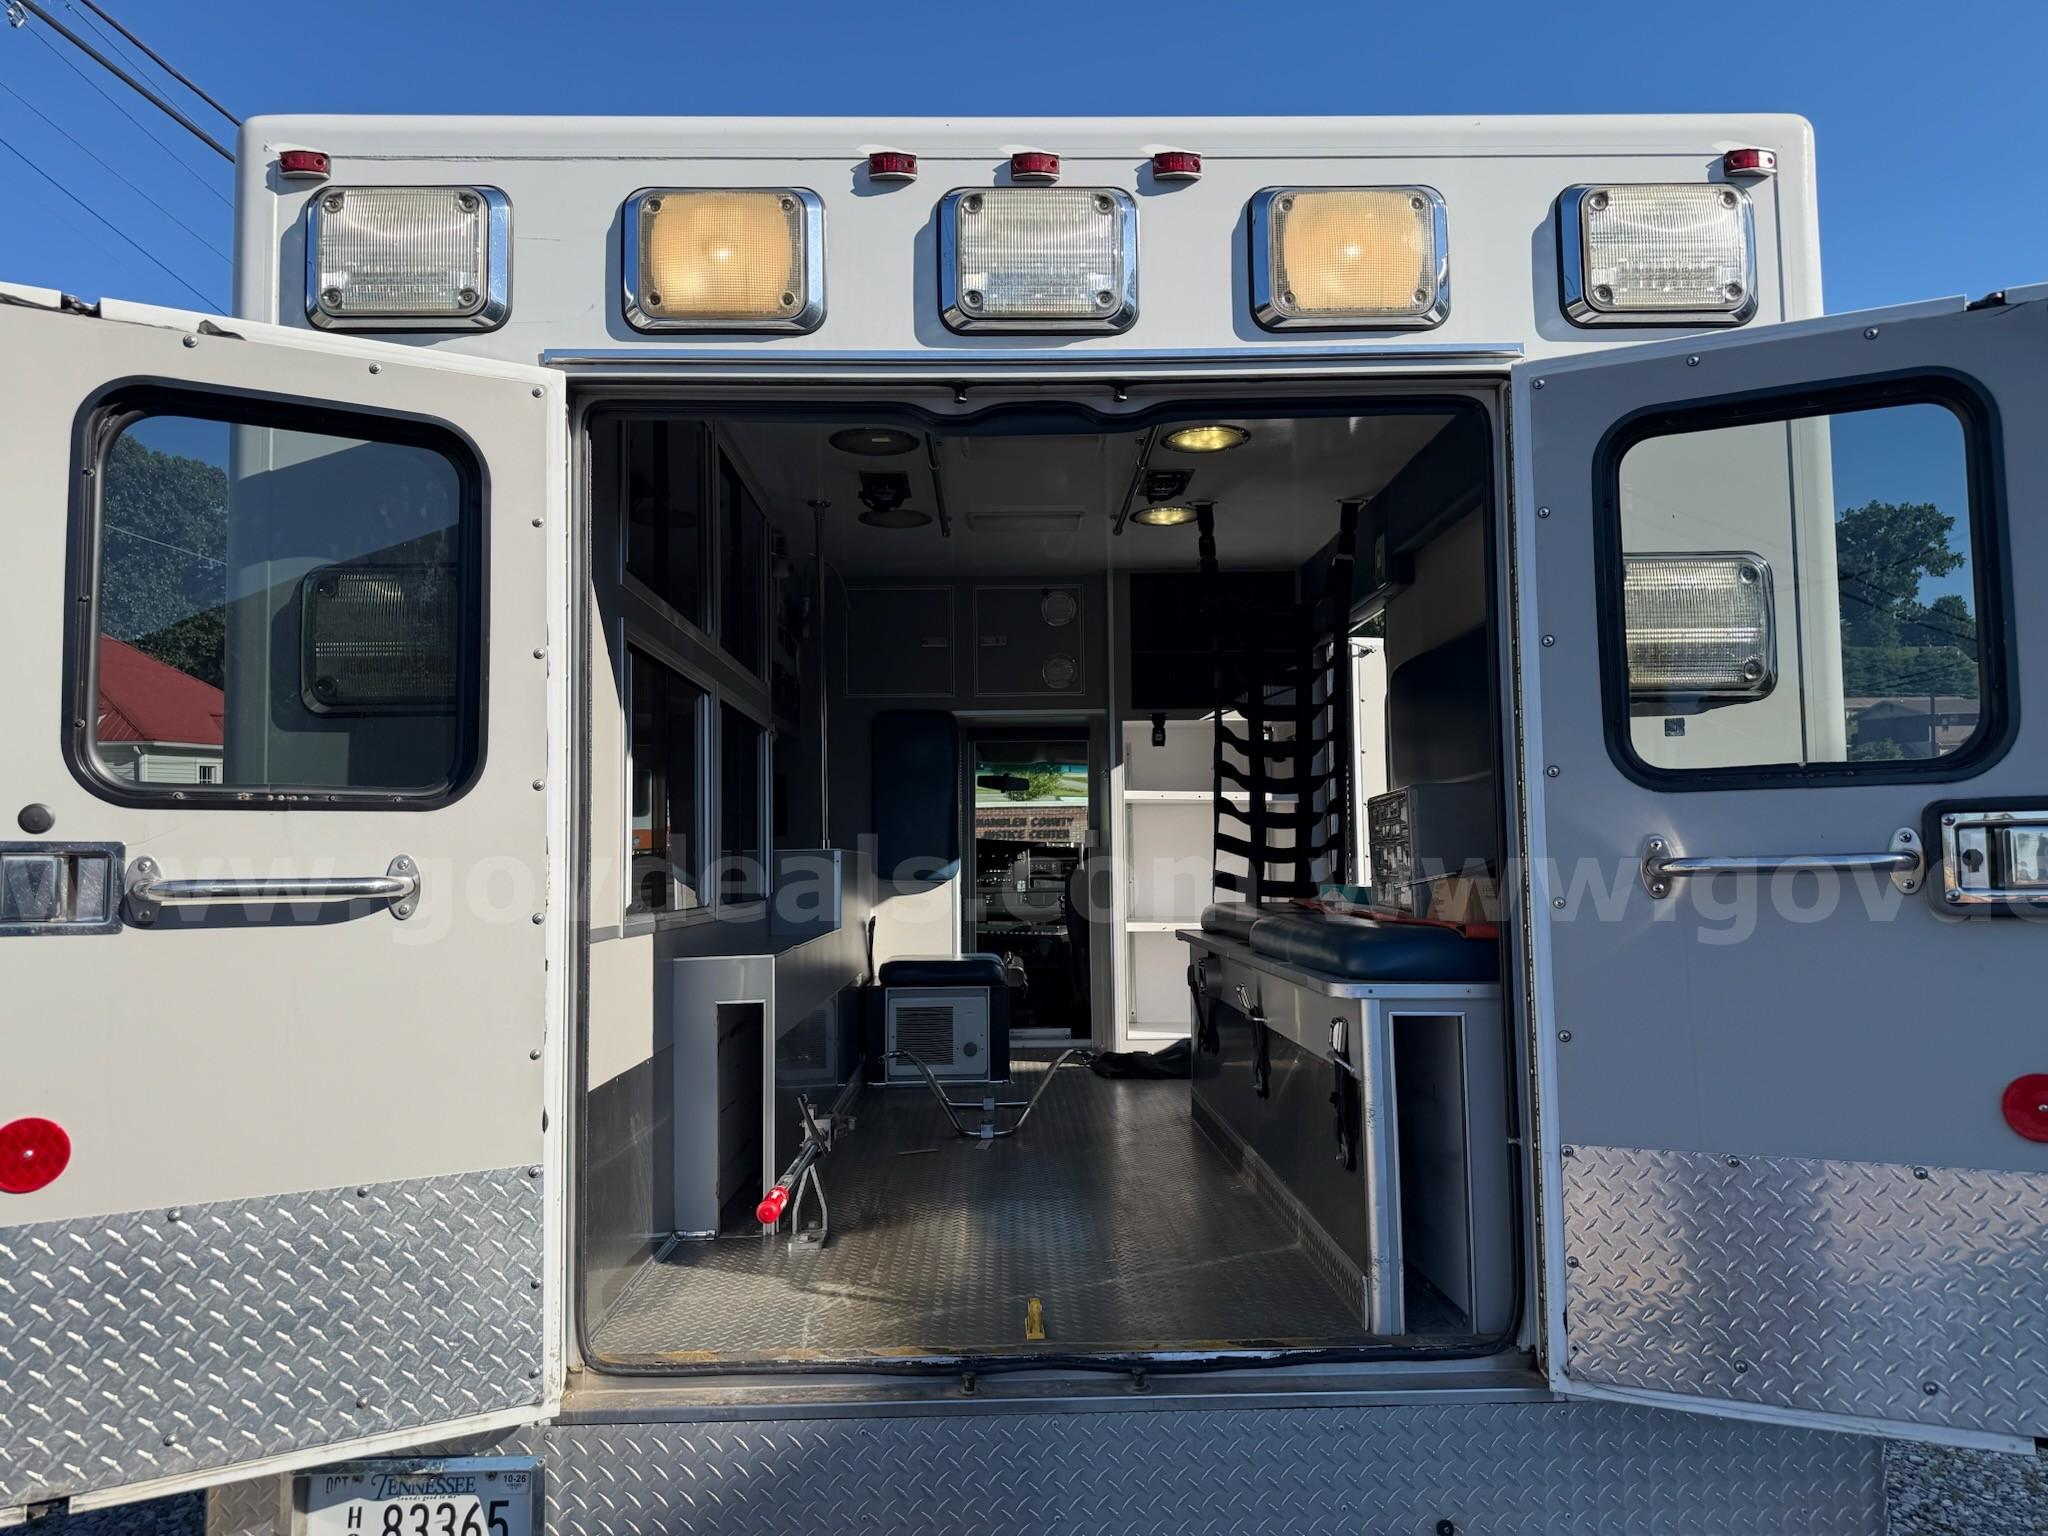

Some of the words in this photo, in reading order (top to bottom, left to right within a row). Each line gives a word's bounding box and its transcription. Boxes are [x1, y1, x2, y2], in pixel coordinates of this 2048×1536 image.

[1031, 817, 1074, 827] COUNTY
[1029, 829, 1070, 839] CENTER
[371, 1473, 476, 1500] TENNESSEE
[503, 1474, 527, 1483] 10-26
[381, 1500, 510, 1536] 83365
